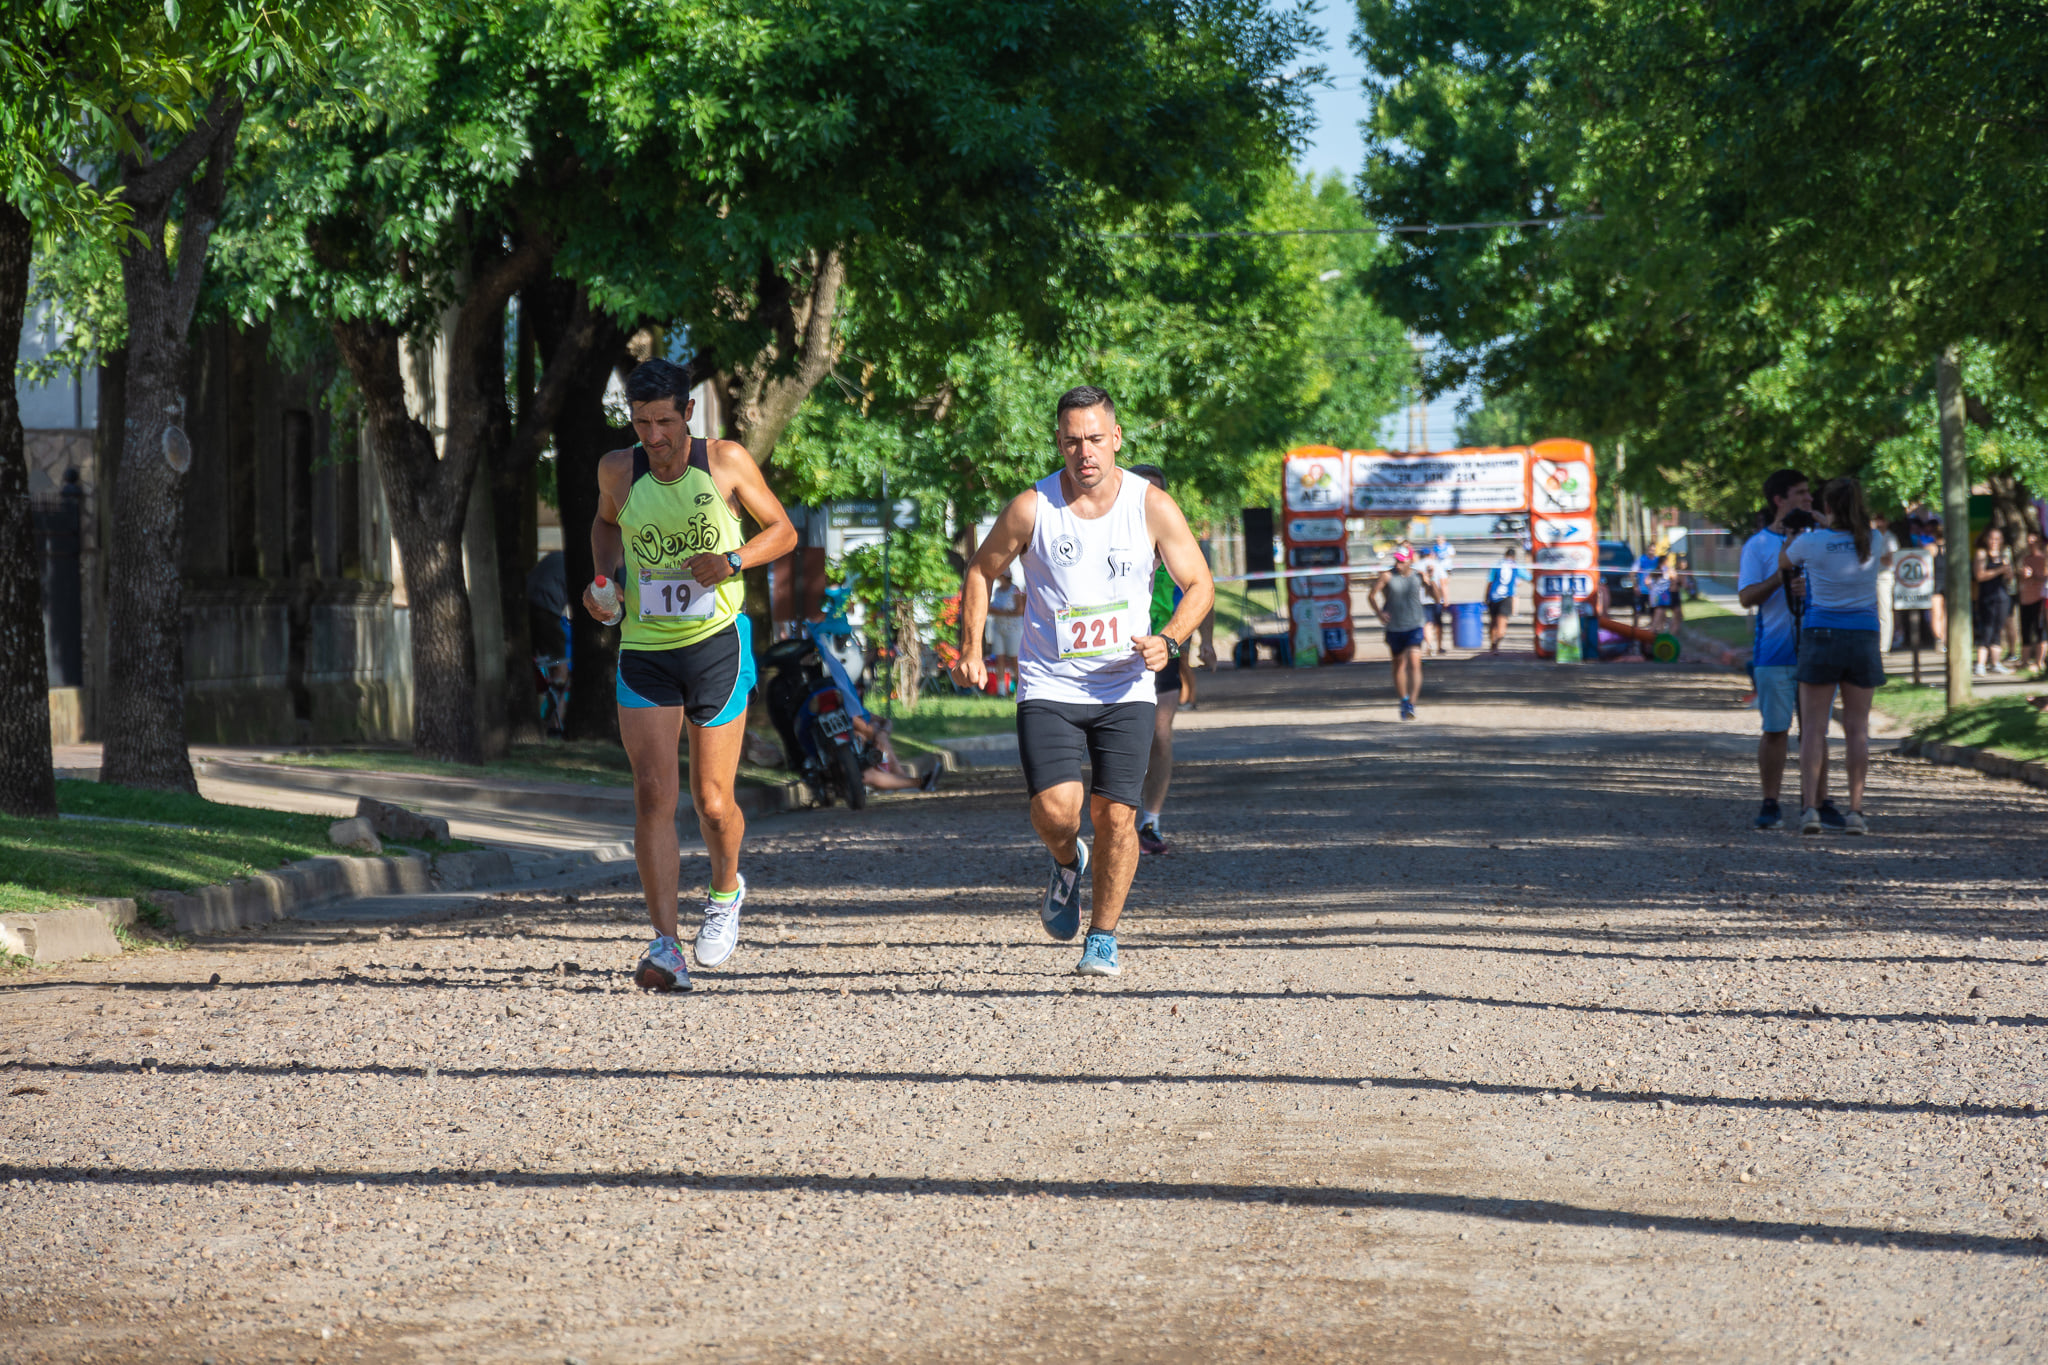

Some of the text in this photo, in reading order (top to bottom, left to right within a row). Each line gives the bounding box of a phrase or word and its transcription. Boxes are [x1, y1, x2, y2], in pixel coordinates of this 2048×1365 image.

[632, 512, 720, 565] Veneto
[1902, 562, 1923, 580] 20
[661, 583, 692, 613] 19
[1071, 616, 1118, 650] 221
